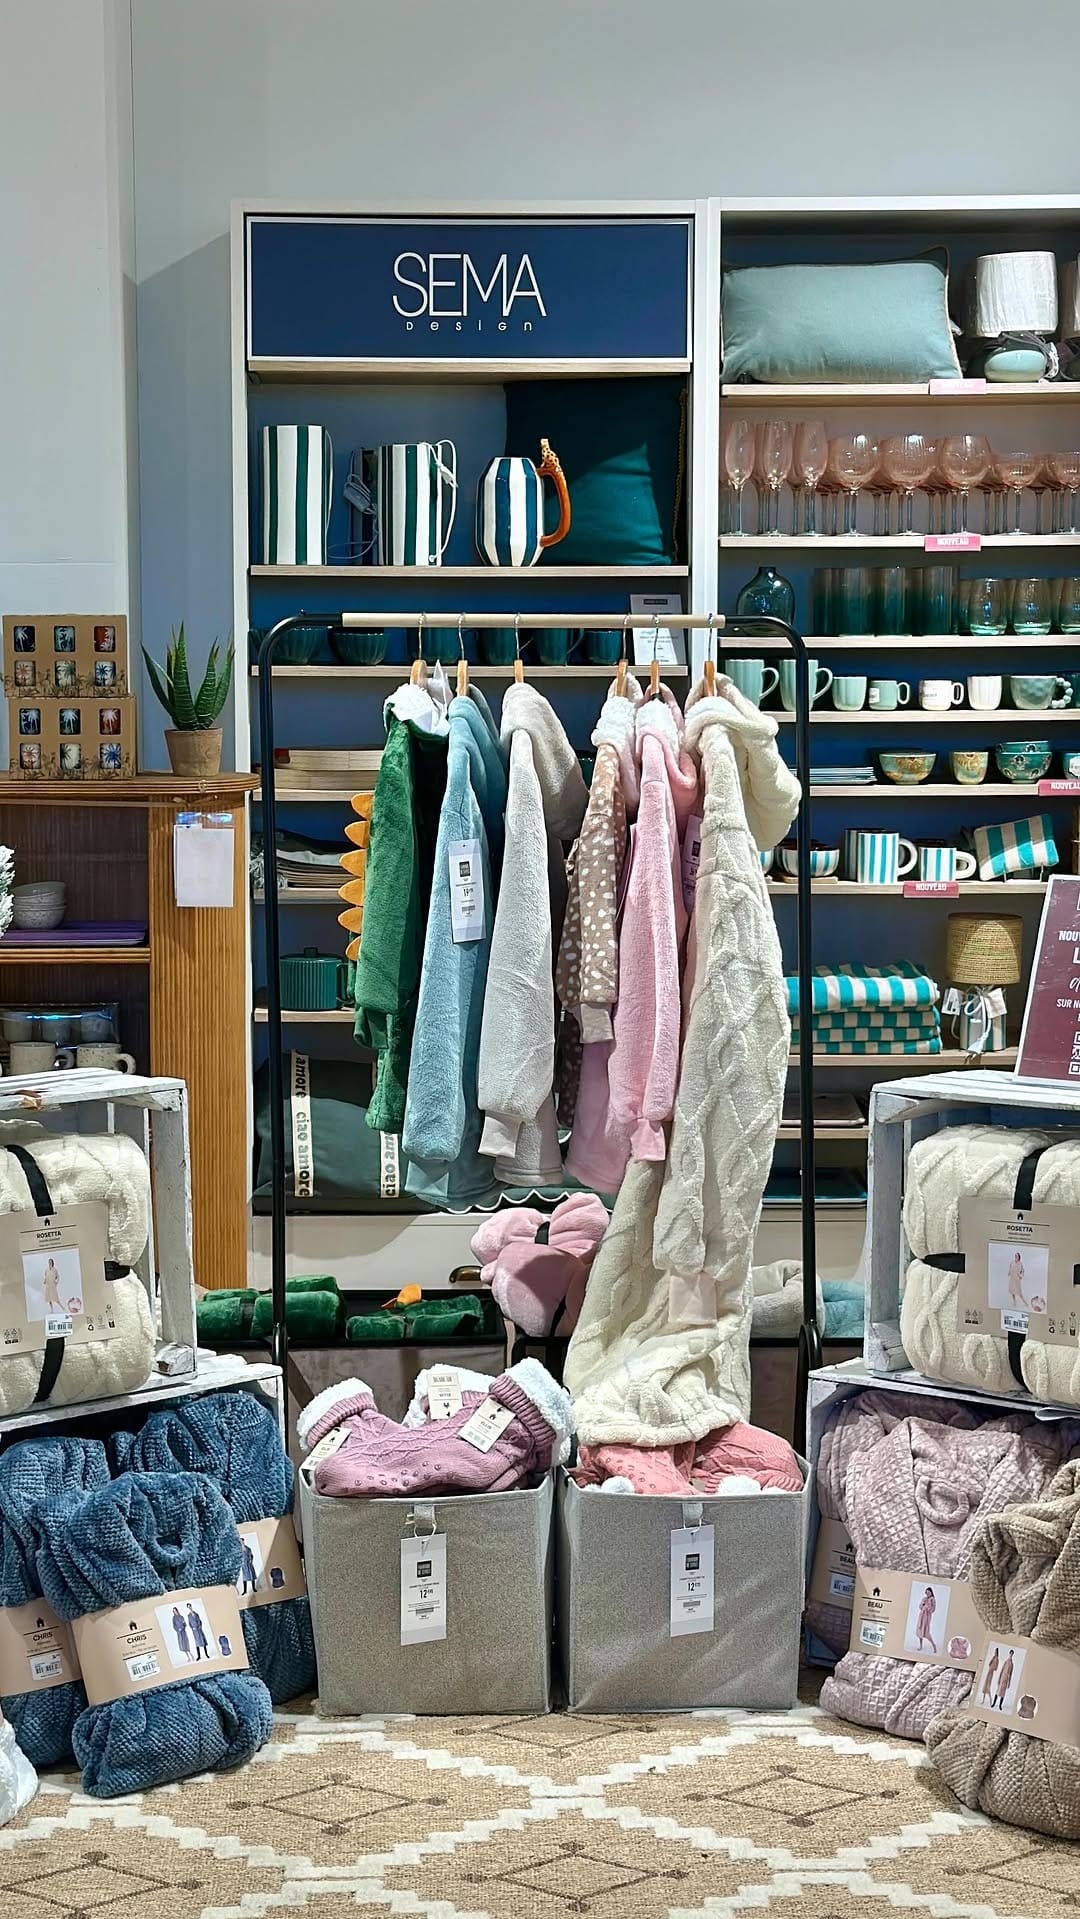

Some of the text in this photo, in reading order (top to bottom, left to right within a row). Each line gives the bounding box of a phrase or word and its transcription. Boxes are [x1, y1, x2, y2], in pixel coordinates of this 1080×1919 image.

[392, 252, 547, 317] SEMA
[915, 883, 948, 891] NOUVEAU
[1056, 998, 1072, 1008] SUR
[295, 1058, 307, 1098] amore
[296, 1112, 310, 1196] ciao amore
[383, 1163, 396, 1196] ciao
[1006, 1225, 1033, 1233] ROSETTA
[36, 1231, 62, 1239] ROSETTA
[867, 1601, 883, 1609] BEAU
[32, 1631, 53, 1641] CHRIS
[126, 1633, 147, 1644] CHRIS
